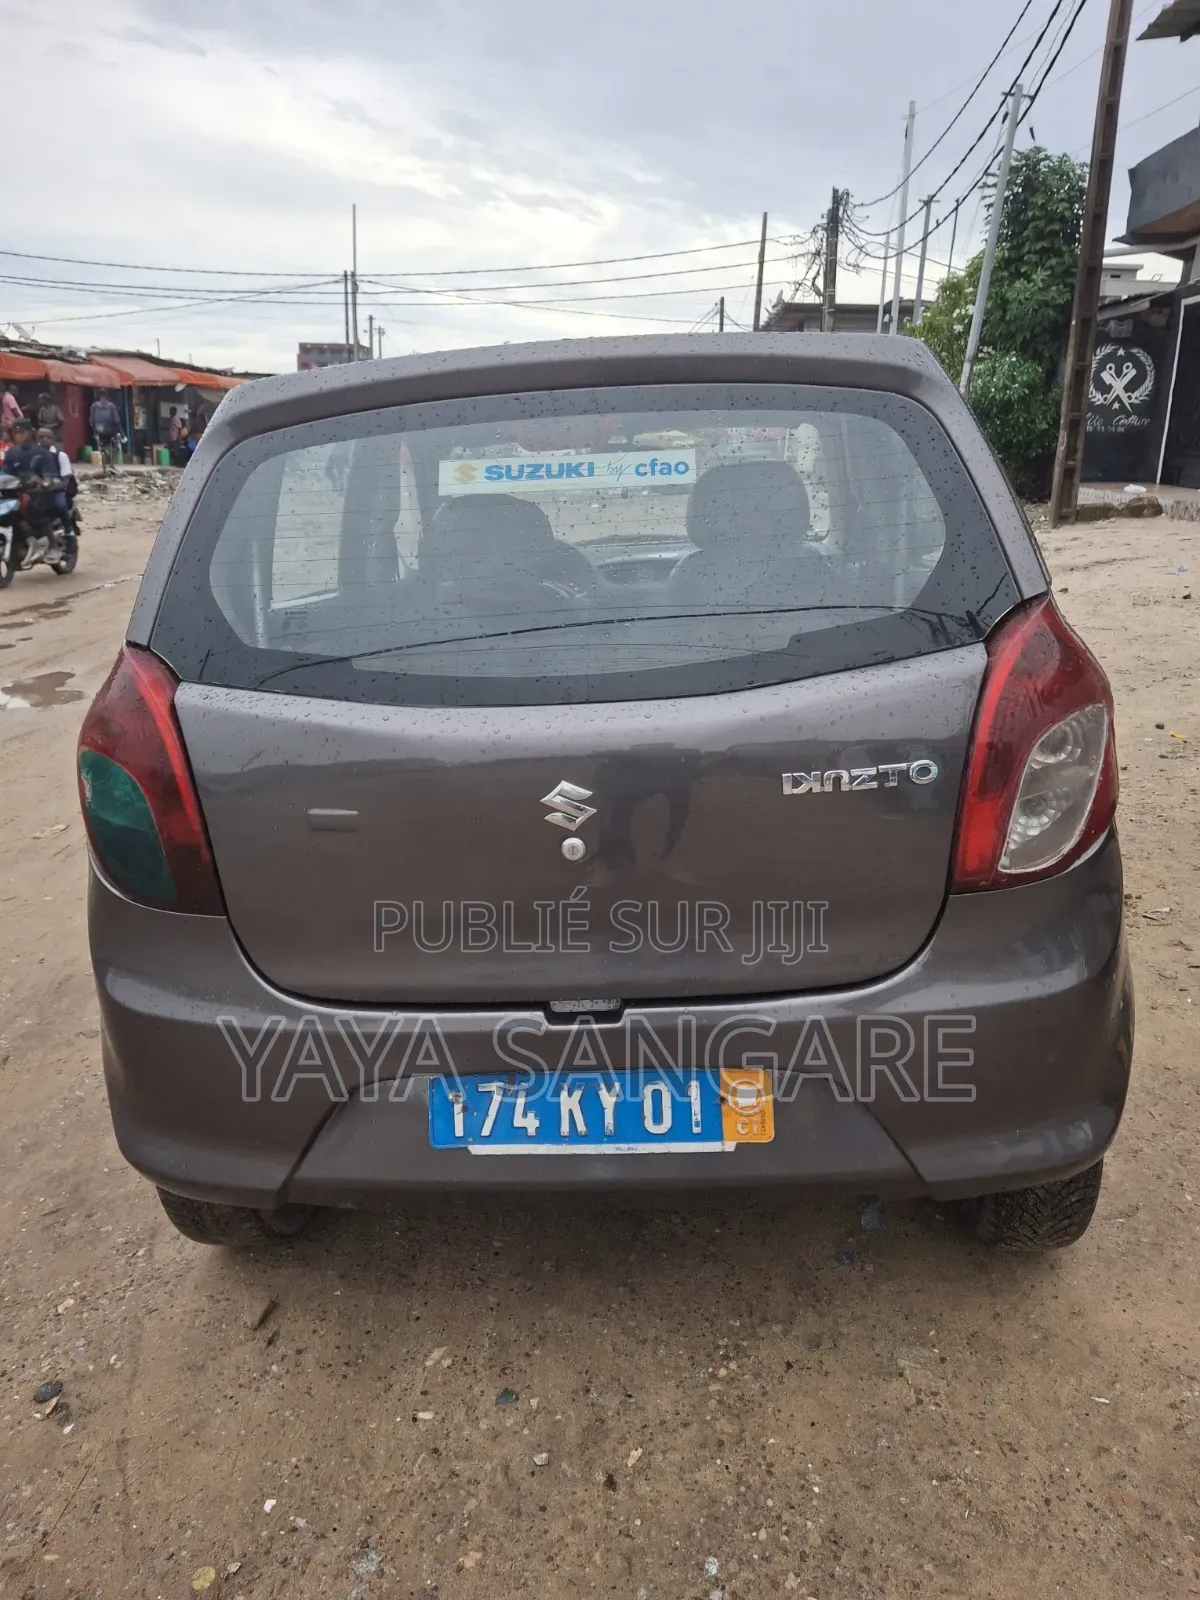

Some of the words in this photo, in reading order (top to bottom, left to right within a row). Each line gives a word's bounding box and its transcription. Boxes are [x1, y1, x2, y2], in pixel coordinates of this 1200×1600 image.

[484, 461, 595, 481] SUZUKI
[634, 457, 690, 477] cfao
[449, 1082, 540, 1137] 174
[560, 1080, 622, 1136] KY
[643, 1080, 703, 1135] 01
